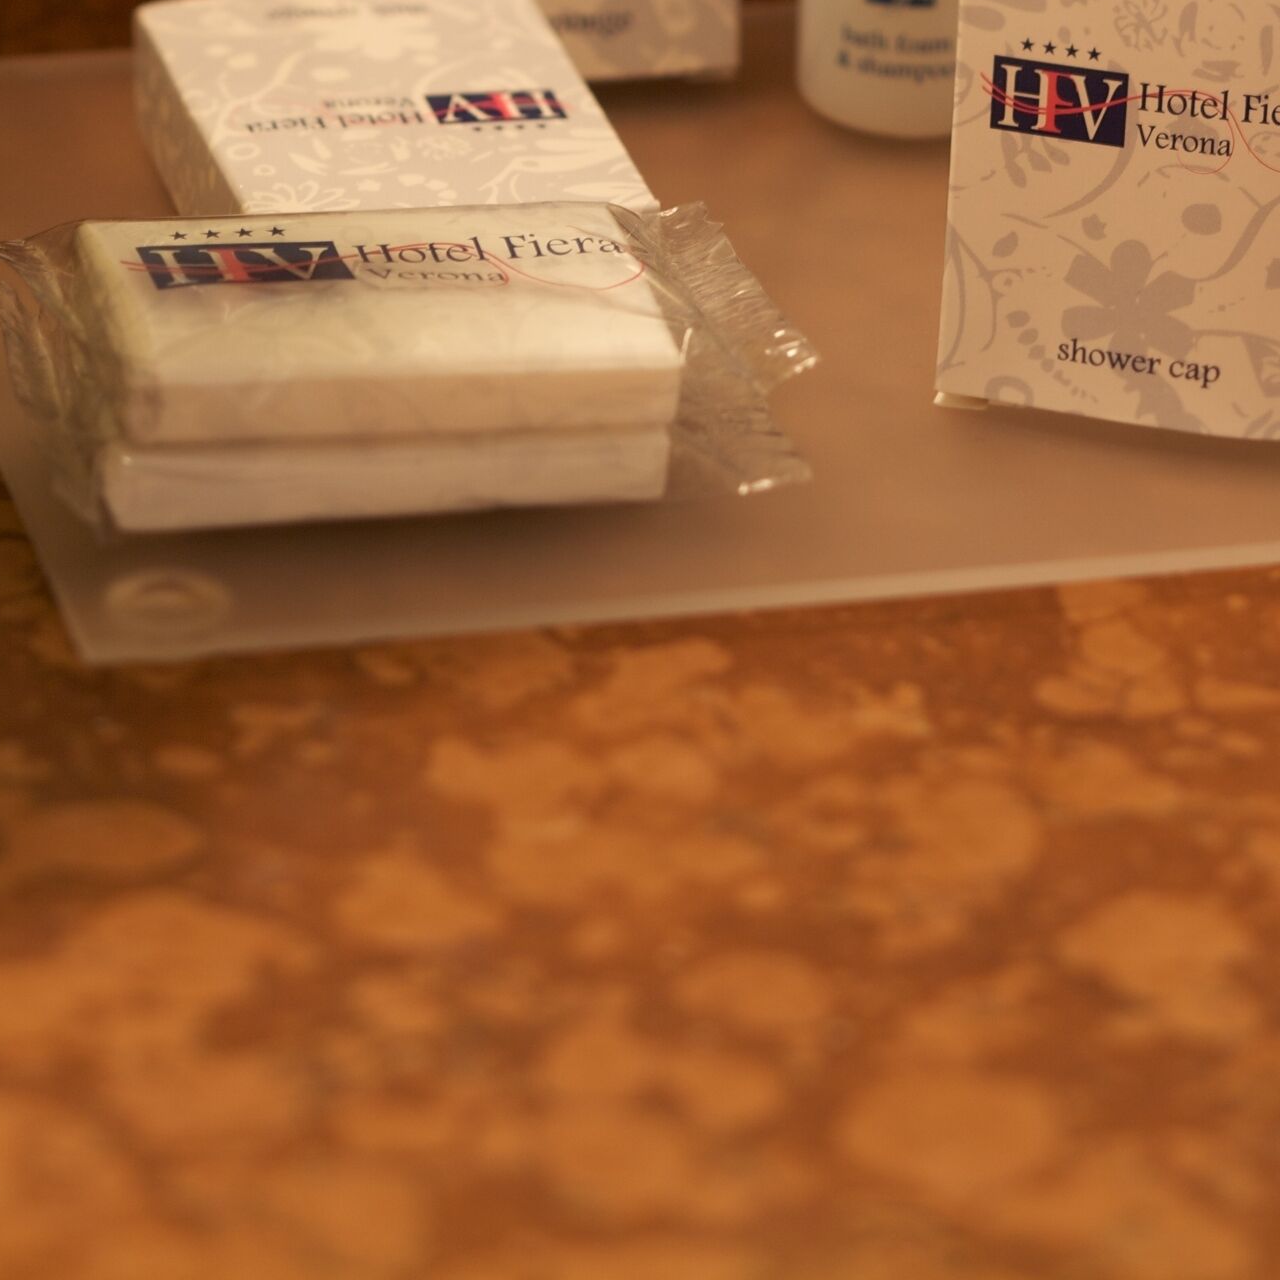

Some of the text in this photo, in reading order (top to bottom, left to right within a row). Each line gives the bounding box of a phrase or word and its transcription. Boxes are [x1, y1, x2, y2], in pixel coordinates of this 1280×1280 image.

[997, 62, 1123, 141] HFV
[1138, 82, 1230, 121] Hotel
[245, 107, 423, 135] Hotel Fiera
[1136, 123, 1233, 157] Verona
[147, 243, 328, 289] HFV
[353, 231, 625, 265] Hotel Fiera
[365, 266, 505, 284] Verona
[1057, 337, 1222, 390] shower cap
